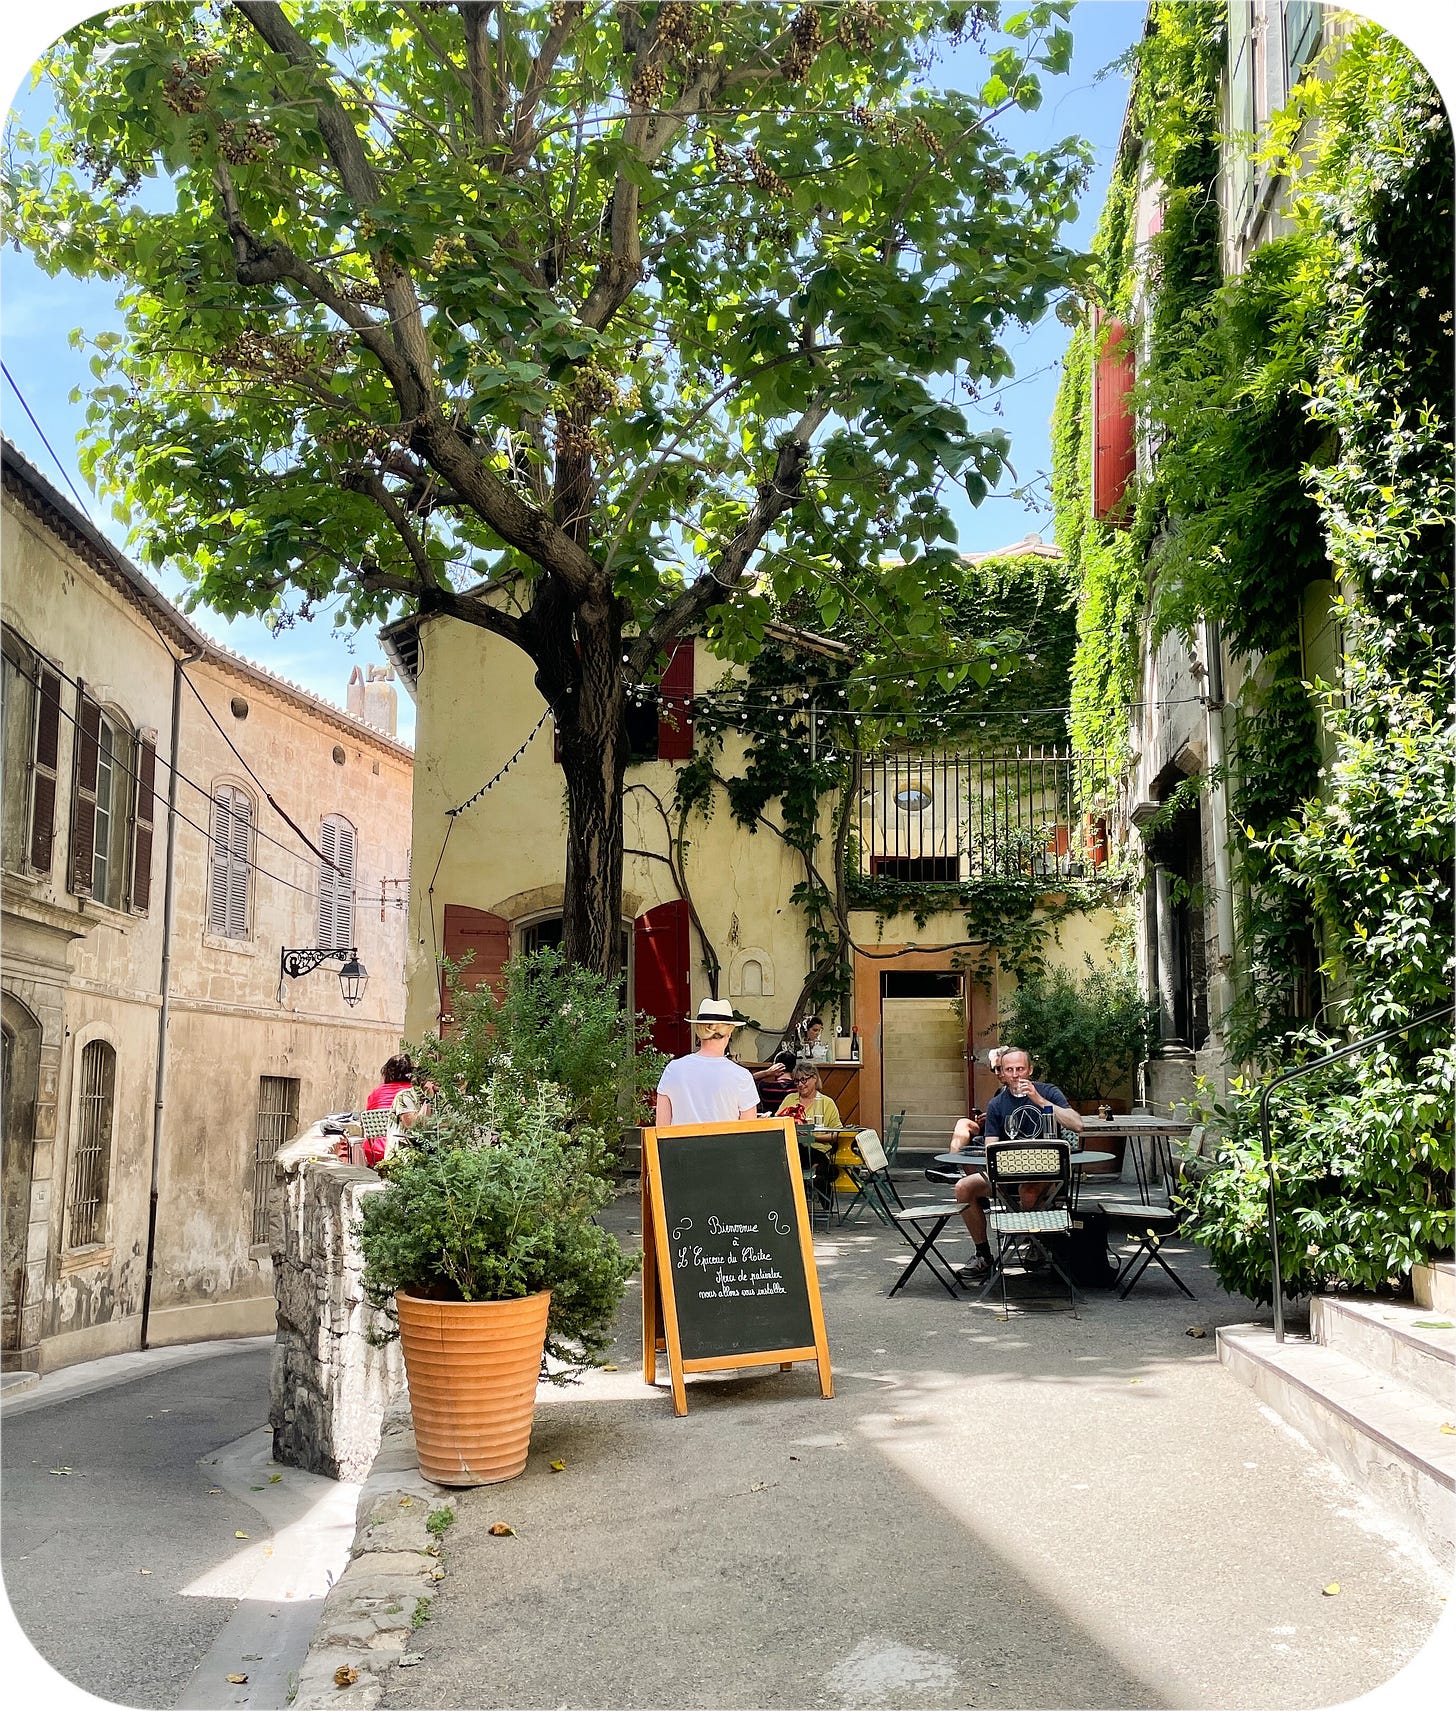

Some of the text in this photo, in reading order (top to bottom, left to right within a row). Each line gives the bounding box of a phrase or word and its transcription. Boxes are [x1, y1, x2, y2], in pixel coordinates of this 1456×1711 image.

[732, 1236, 740, 1247] à
[727, 1251, 737, 1264] du
[715, 1266, 782, 1285] Merci de patienter
[699, 1282, 787, 1299] nous allons vous installer
